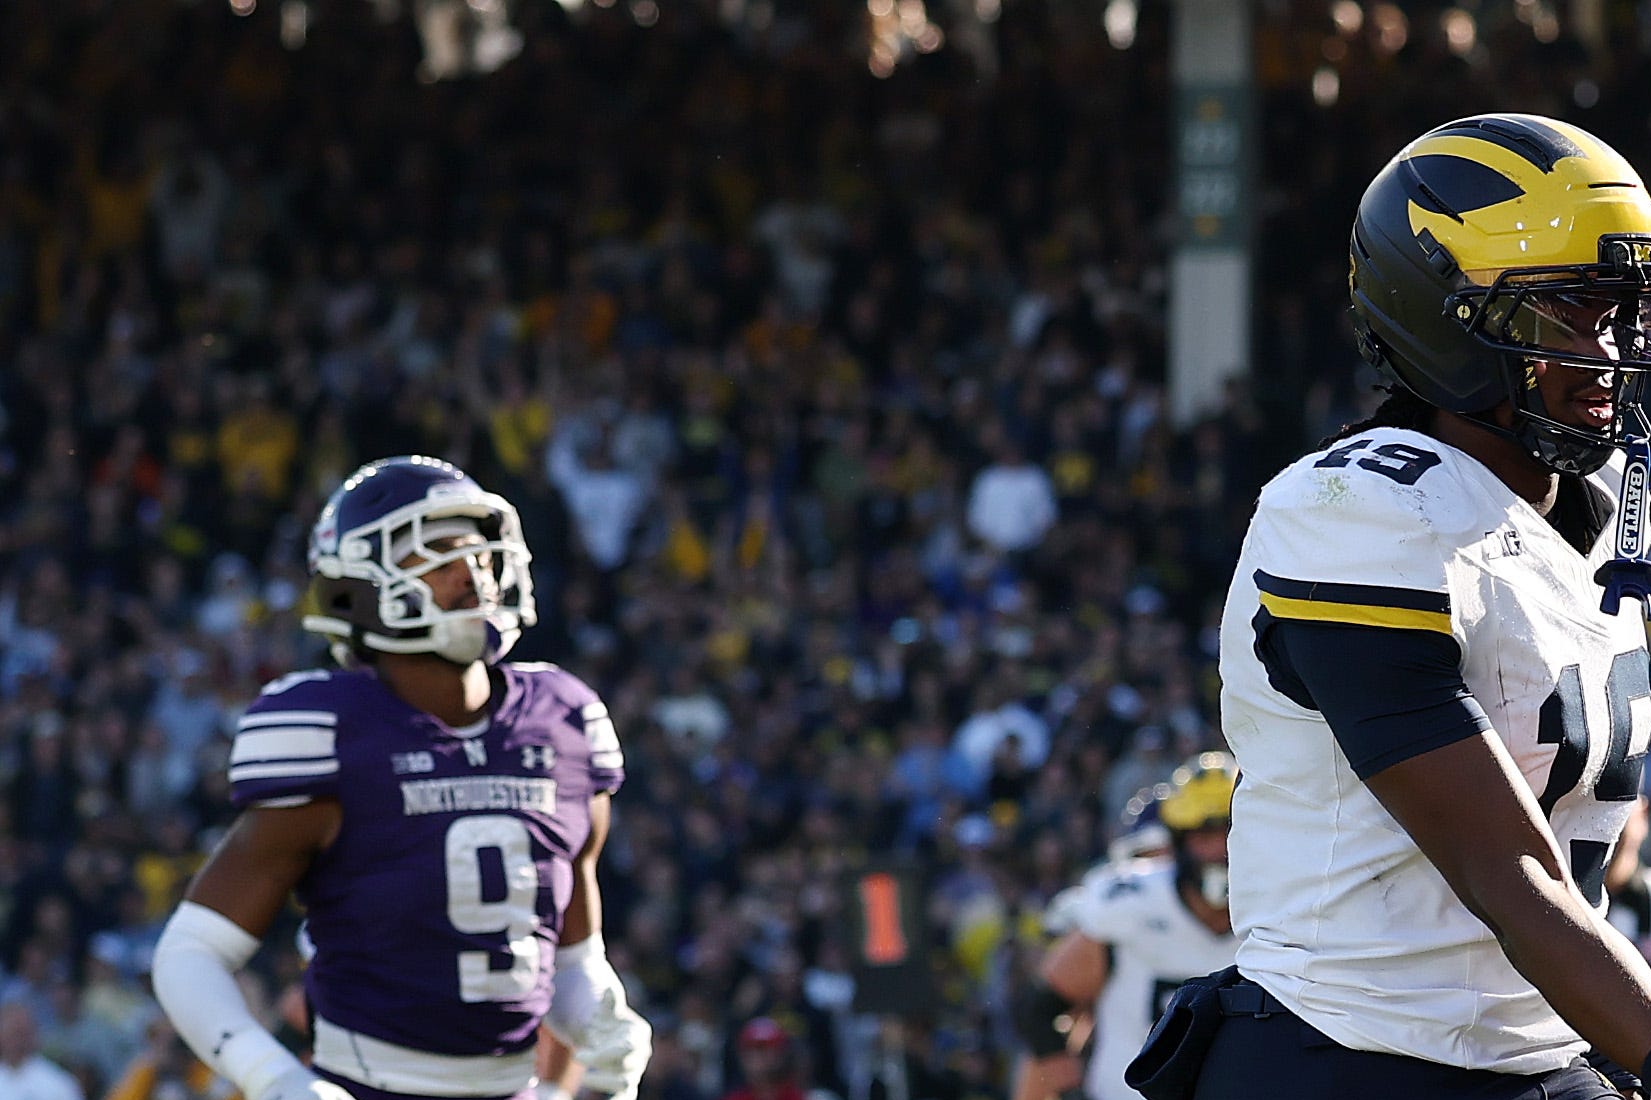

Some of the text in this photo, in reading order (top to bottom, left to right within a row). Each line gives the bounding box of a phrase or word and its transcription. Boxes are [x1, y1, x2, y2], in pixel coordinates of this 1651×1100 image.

[1632, 243, 1651, 262] M
[1313, 439, 1442, 486] 19
[1622, 470, 1643, 550] BATTLE
[463, 739, 488, 767] N
[401, 775, 557, 816] NORTHWESTERN
[445, 815, 540, 1003] 9
